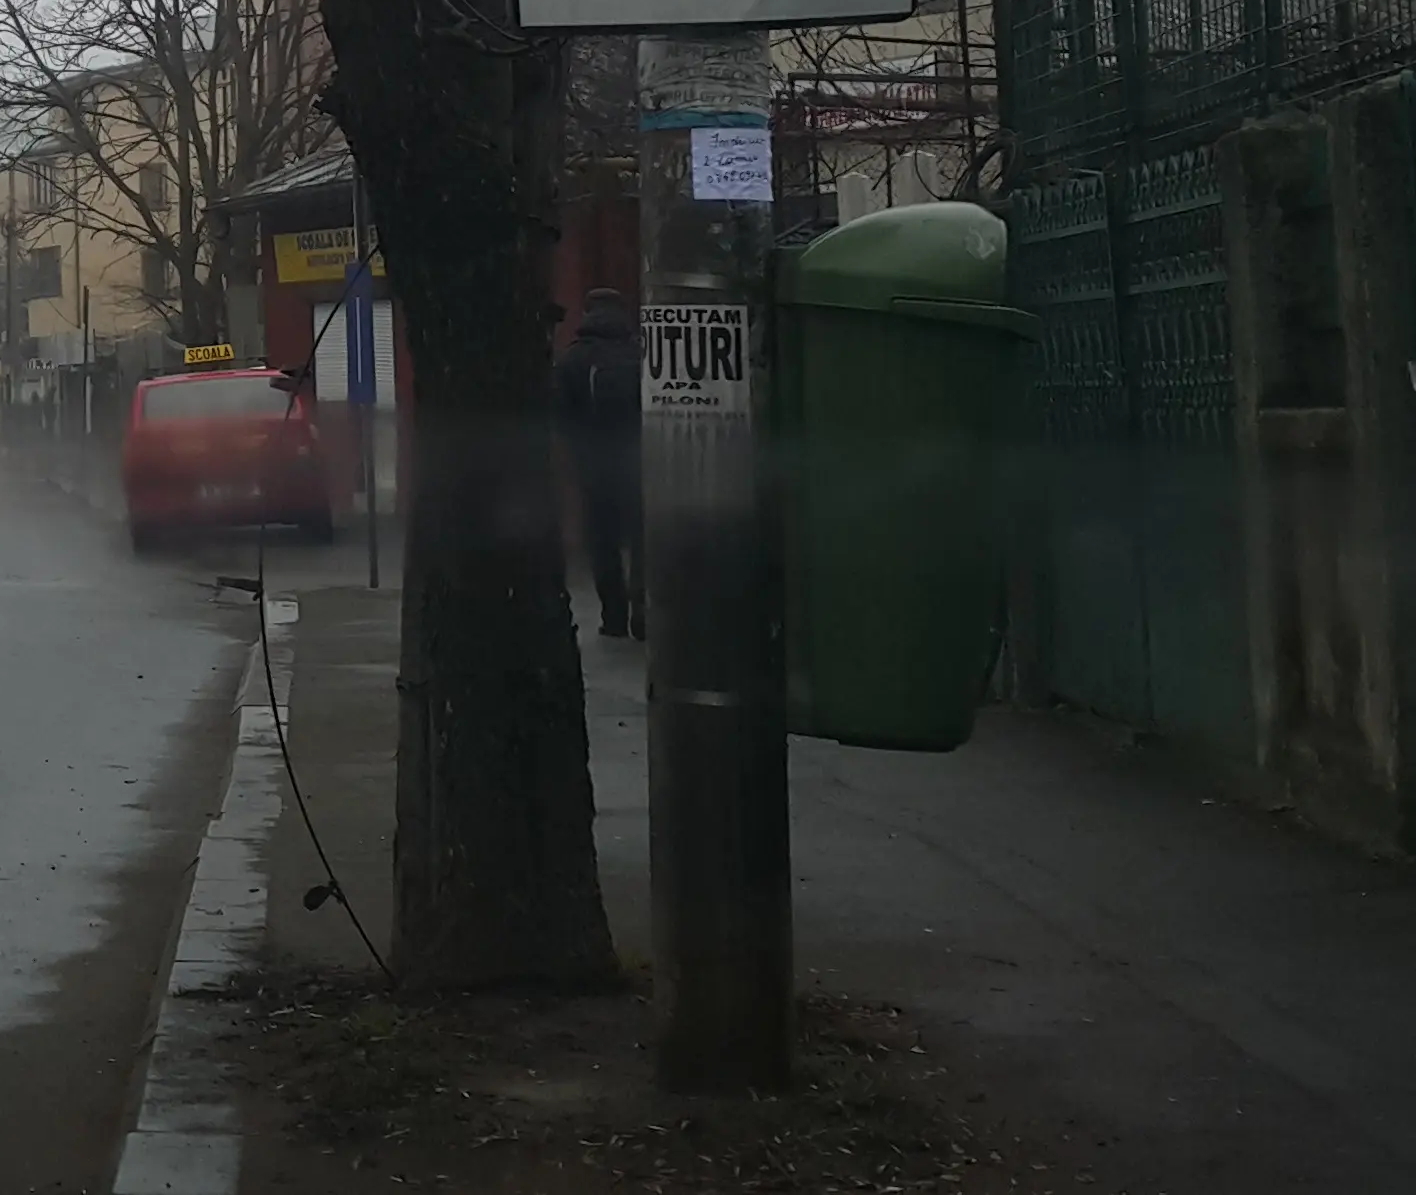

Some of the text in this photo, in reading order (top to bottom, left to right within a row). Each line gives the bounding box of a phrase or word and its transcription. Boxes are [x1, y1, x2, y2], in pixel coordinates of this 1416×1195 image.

[188, 346, 231, 361] SCOALA
[641, 325, 743, 381] UTURI
[662, 382, 702, 390] APA
